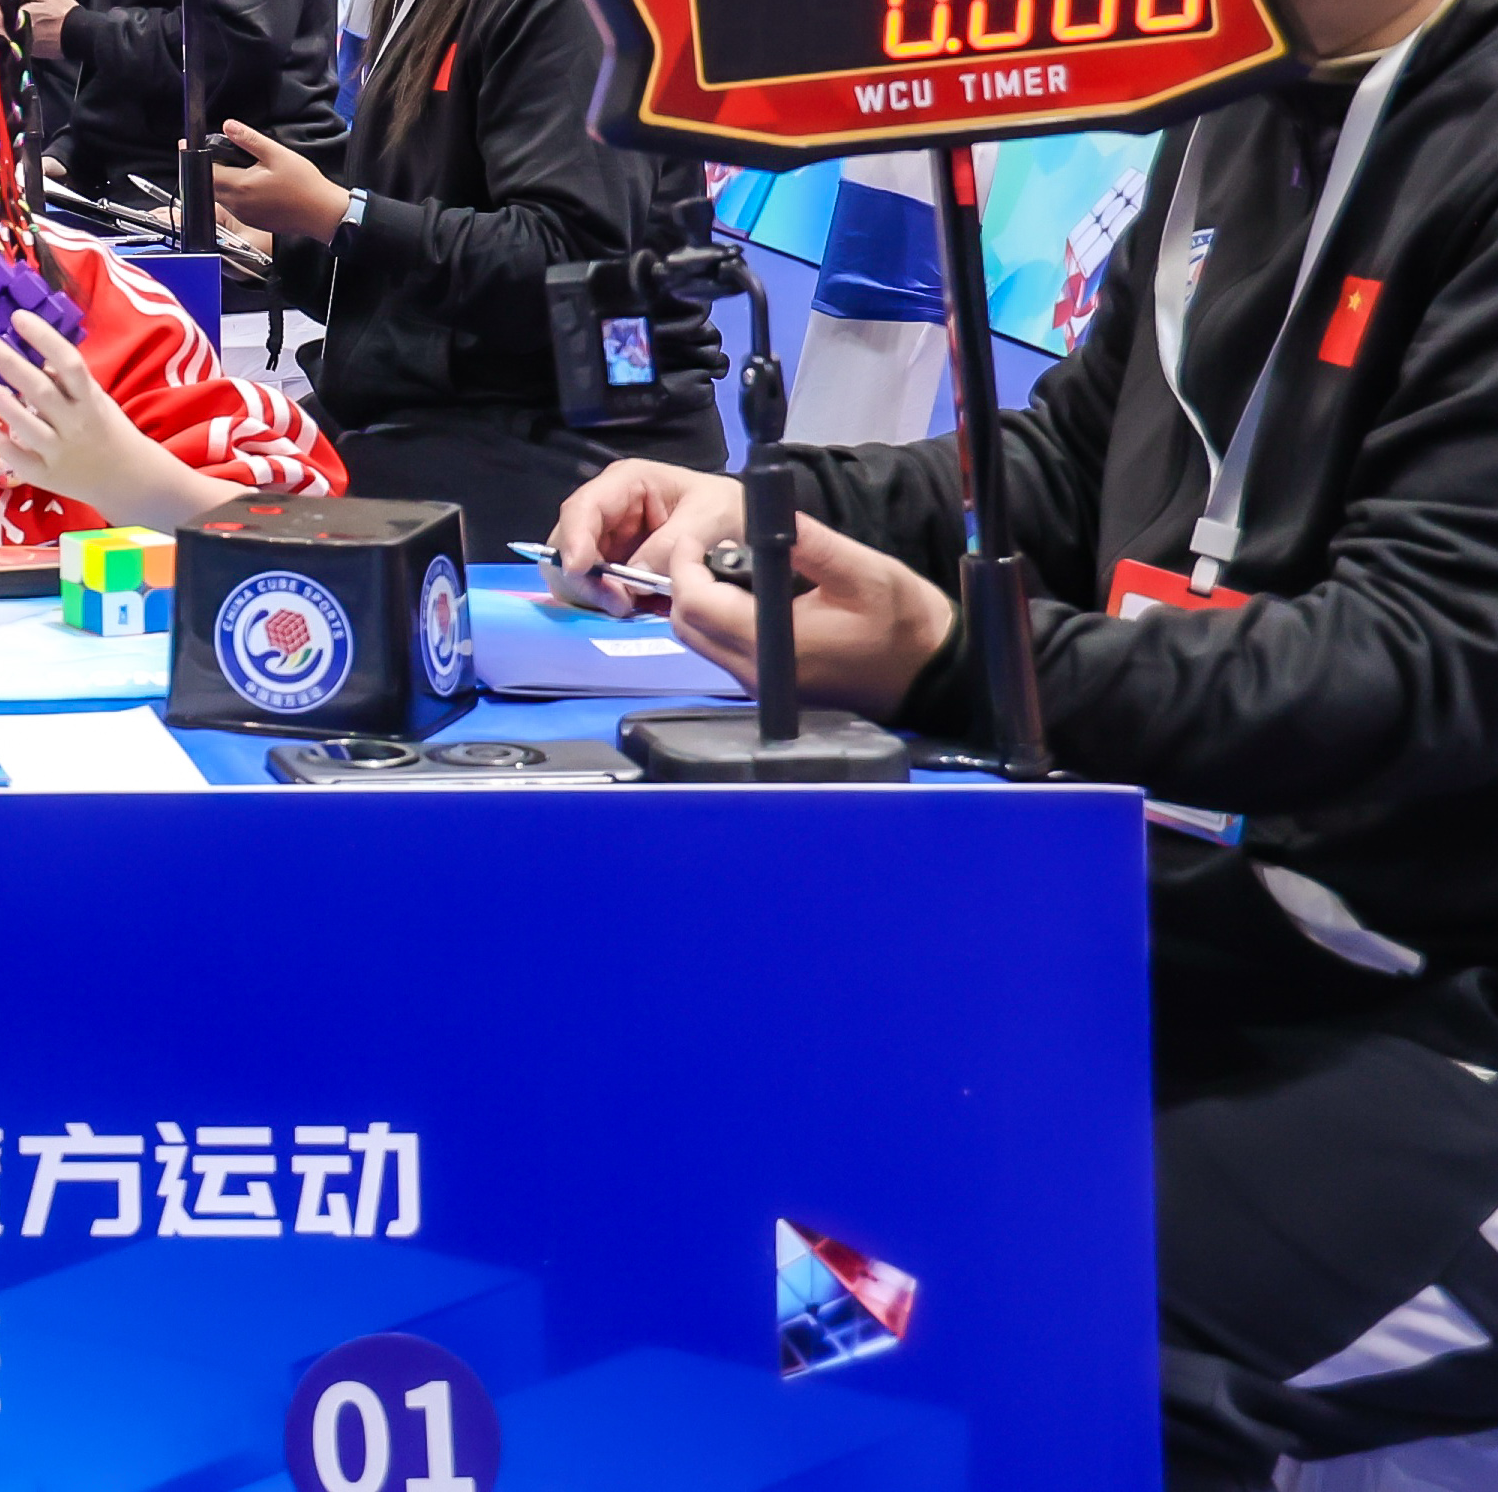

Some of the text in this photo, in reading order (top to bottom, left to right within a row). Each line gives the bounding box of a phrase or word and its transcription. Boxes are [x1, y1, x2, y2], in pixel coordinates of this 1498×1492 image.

[855, 64, 1068, 112] WCU TIMER
[312, 1380, 476, 1492] 01
